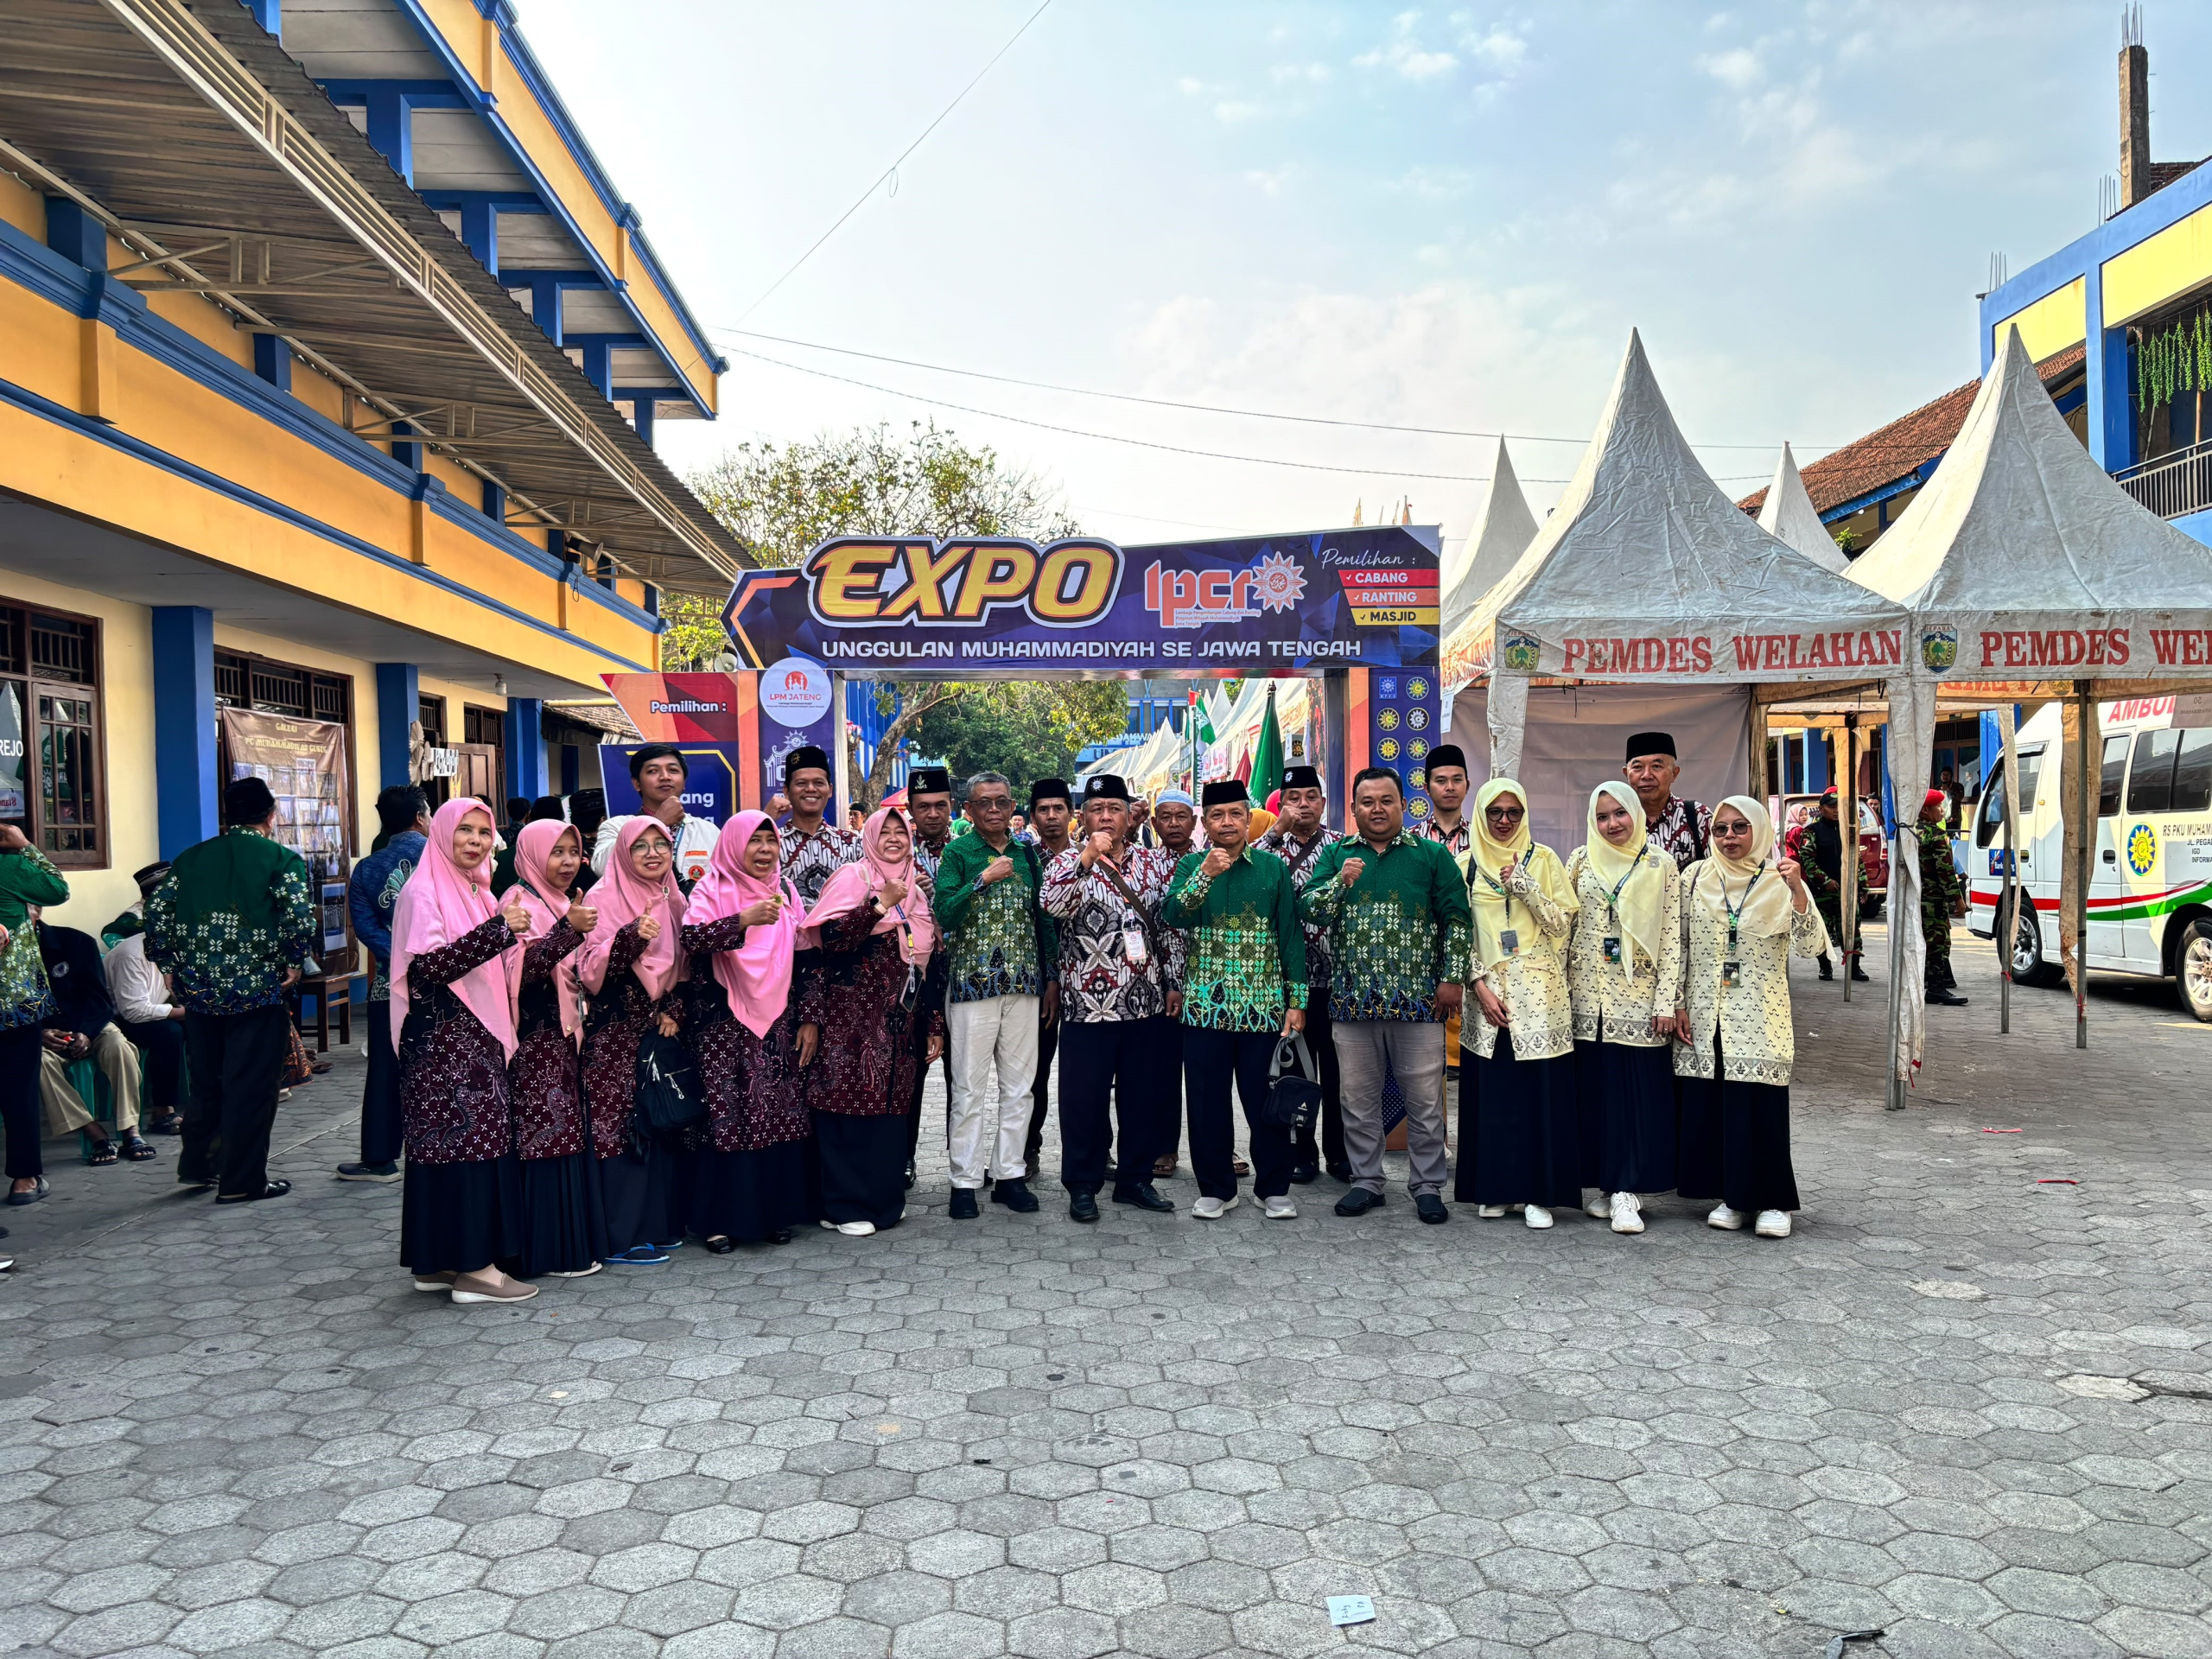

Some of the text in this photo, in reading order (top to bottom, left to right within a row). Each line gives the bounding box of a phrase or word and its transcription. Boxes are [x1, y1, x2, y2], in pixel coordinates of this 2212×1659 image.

[1321, 548, 1404, 569] Pemilihan
[810, 545, 1115, 617] EXPO
[1355, 572, 1408, 583] CABANG
[1362, 592, 1417, 602] RANTING
[1370, 611, 1416, 622] MASJID
[822, 640, 1361, 658] UNGGULAN MUHAMMADIYAH SE JAWA TENGAH
[1561, 630, 1901, 673] PEMDES WELAHAN
[1980, 629, 2131, 667] PEMDES
[651, 700, 719, 713] Pemilihan
[2163, 824, 2171, 836] RS
[2172, 824, 2185, 836] PKU
